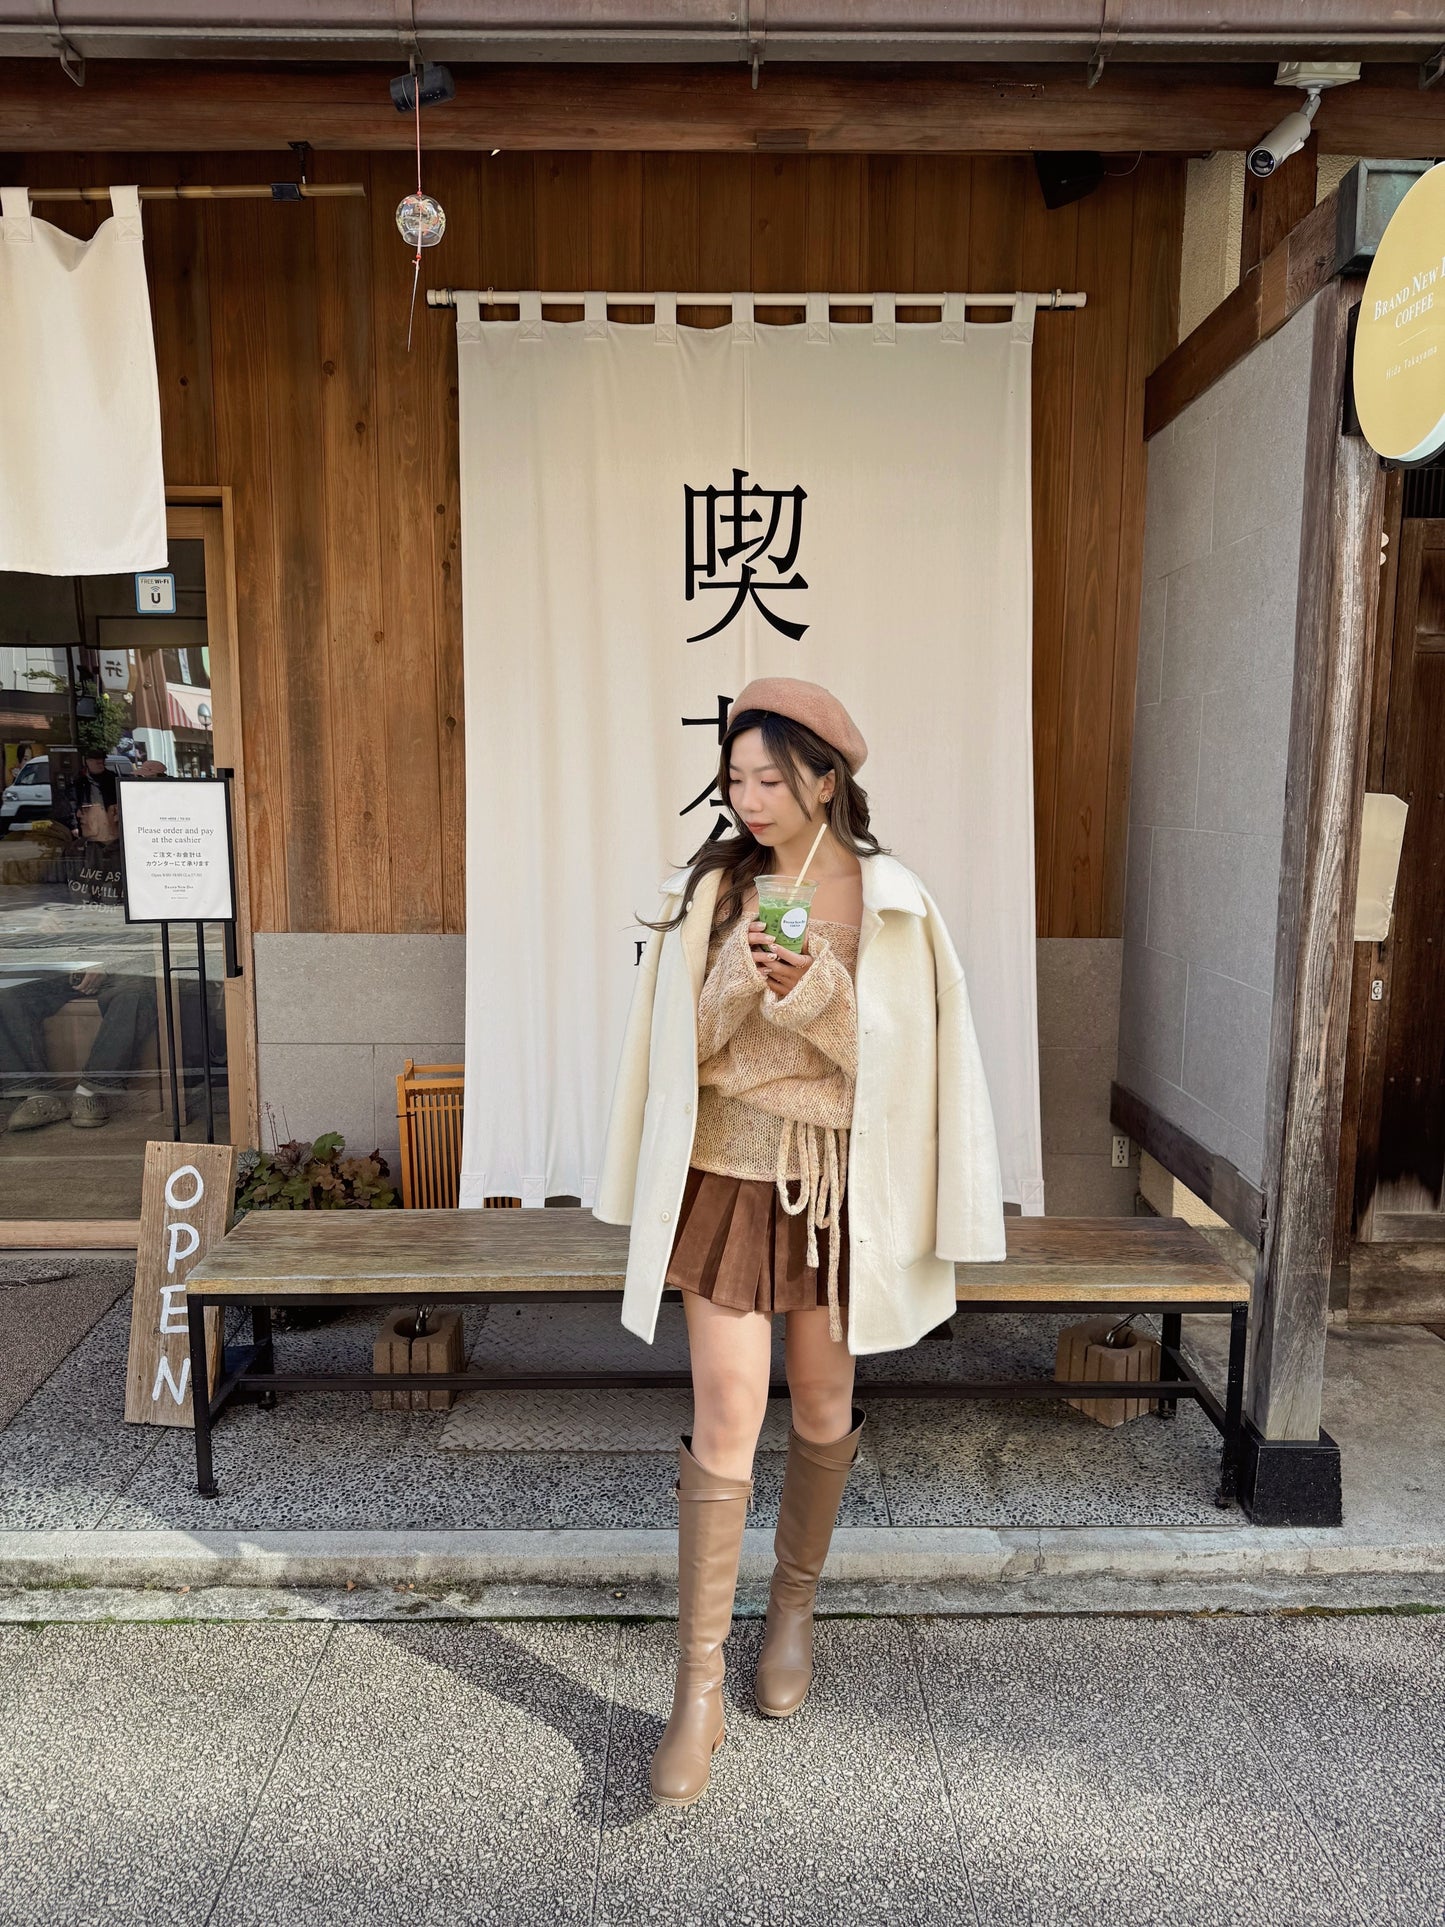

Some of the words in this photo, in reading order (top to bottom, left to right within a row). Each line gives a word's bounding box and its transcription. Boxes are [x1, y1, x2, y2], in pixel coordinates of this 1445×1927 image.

[1374, 287, 1410, 321] BRAND
[1412, 267, 1439, 297] NEW
[1395, 292, 1434, 329] COFFEE
[137, 826, 161, 834] Please
[163, 826, 183, 834] order
[185, 827, 199, 835] and
[201, 828, 214, 836] pay
[161, 836, 173, 844] the
[175, 836, 201, 844] cashier
[80, 868, 103, 880] LIVE
[105, 871, 121, 882] AS
[91, 885, 118, 898] WILL
[152, 1164, 204, 1405] OPEN
